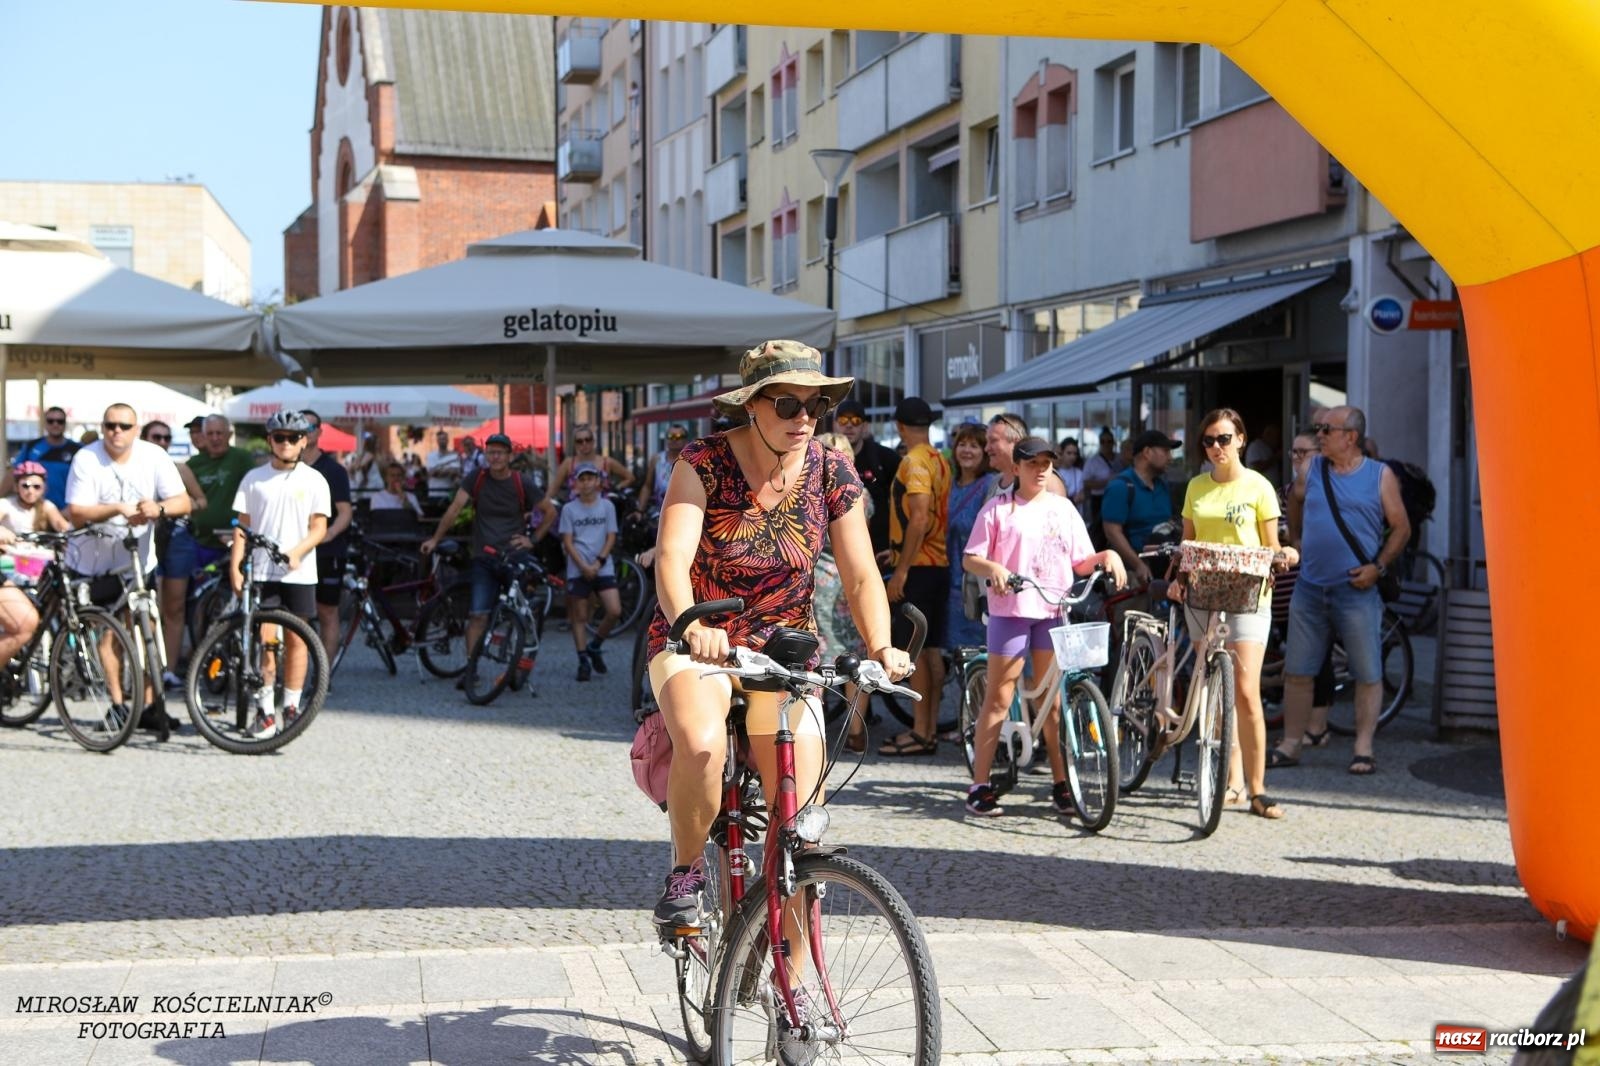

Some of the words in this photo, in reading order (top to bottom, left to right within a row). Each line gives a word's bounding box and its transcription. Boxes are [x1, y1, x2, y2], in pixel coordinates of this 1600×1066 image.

[503, 308, 618, 338] gelatopiu
[947, 342, 979, 384] empik
[344, 401, 391, 415] ŻYWIEC
